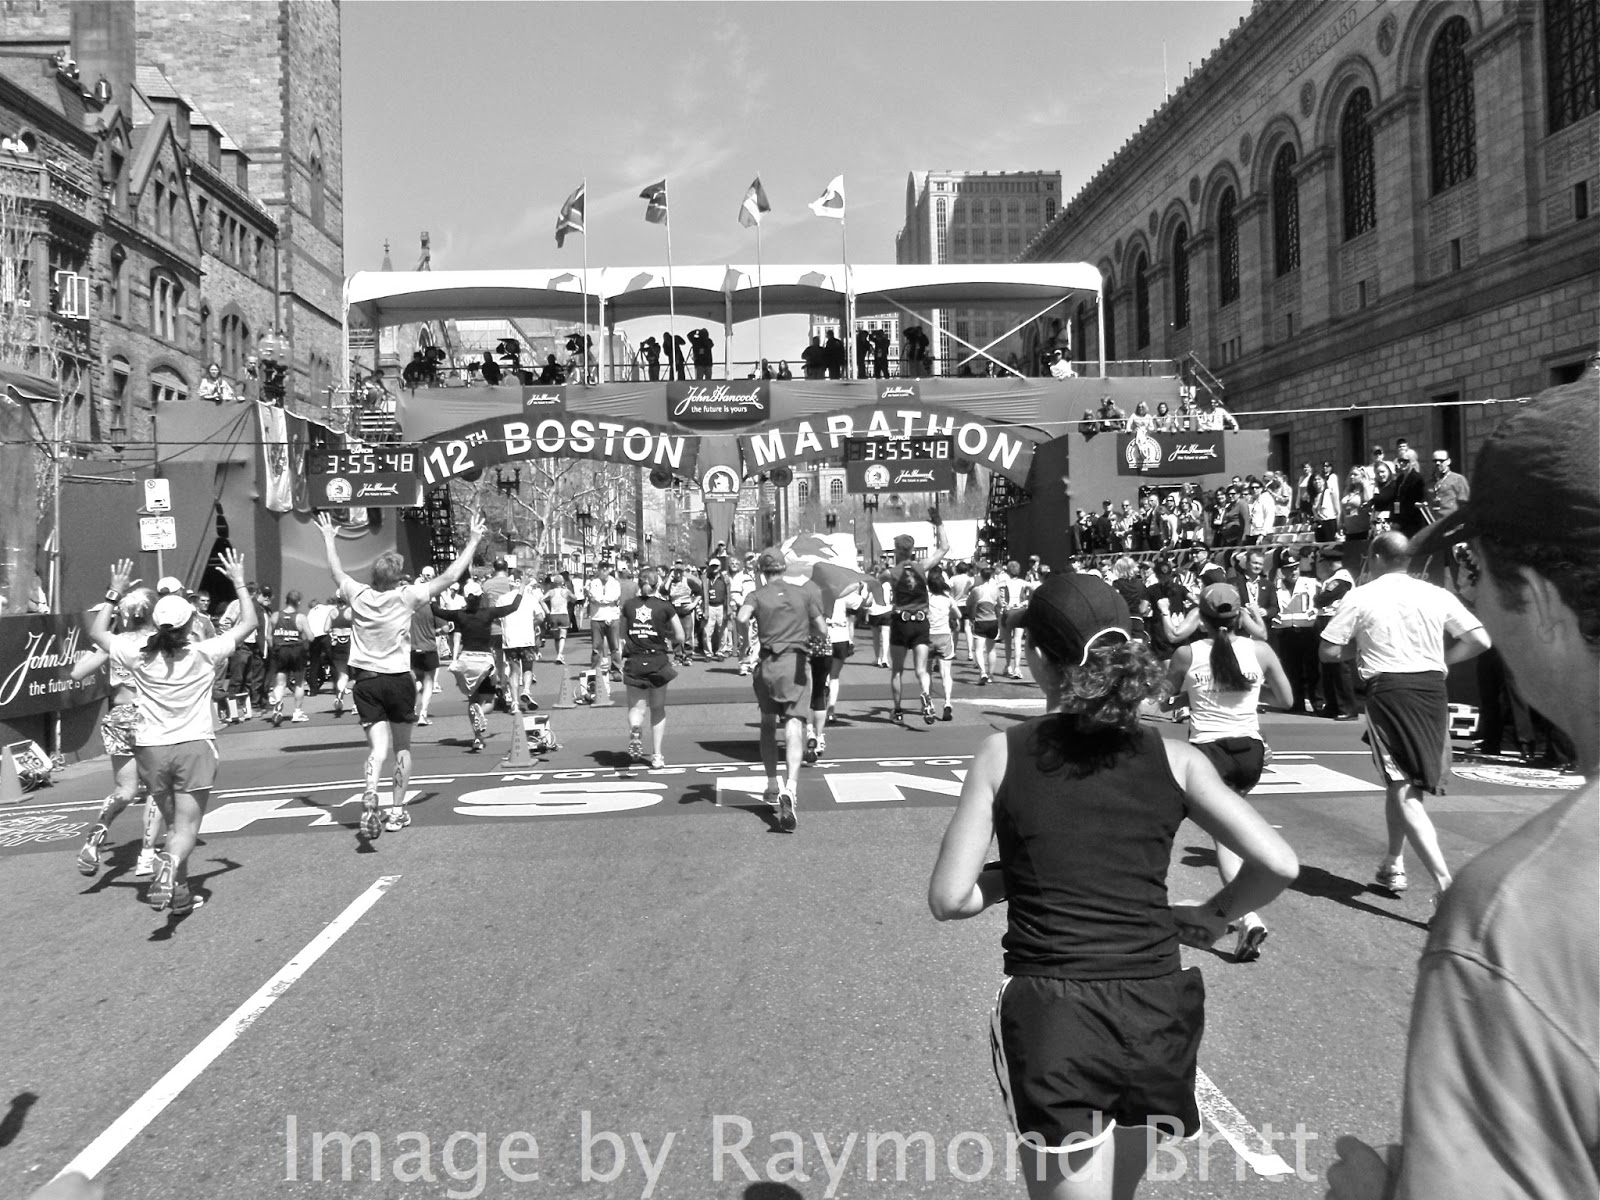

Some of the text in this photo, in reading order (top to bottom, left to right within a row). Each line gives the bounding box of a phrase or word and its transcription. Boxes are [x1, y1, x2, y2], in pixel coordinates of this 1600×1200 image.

[1286, 8, 1357, 82] SAFEGUARD
[674, 385, 712, 415] John
[691, 405, 748, 414] the future is yours
[503, 419, 685, 469] BOSTON
[751, 409, 1022, 471] MARATHON
[864, 441, 949, 461] 3:55:48
[326, 453, 414, 474] 3:55:48
[0, 631, 60, 706] John
[29, 681, 47, 696] the
[48, 679, 73, 693] future
